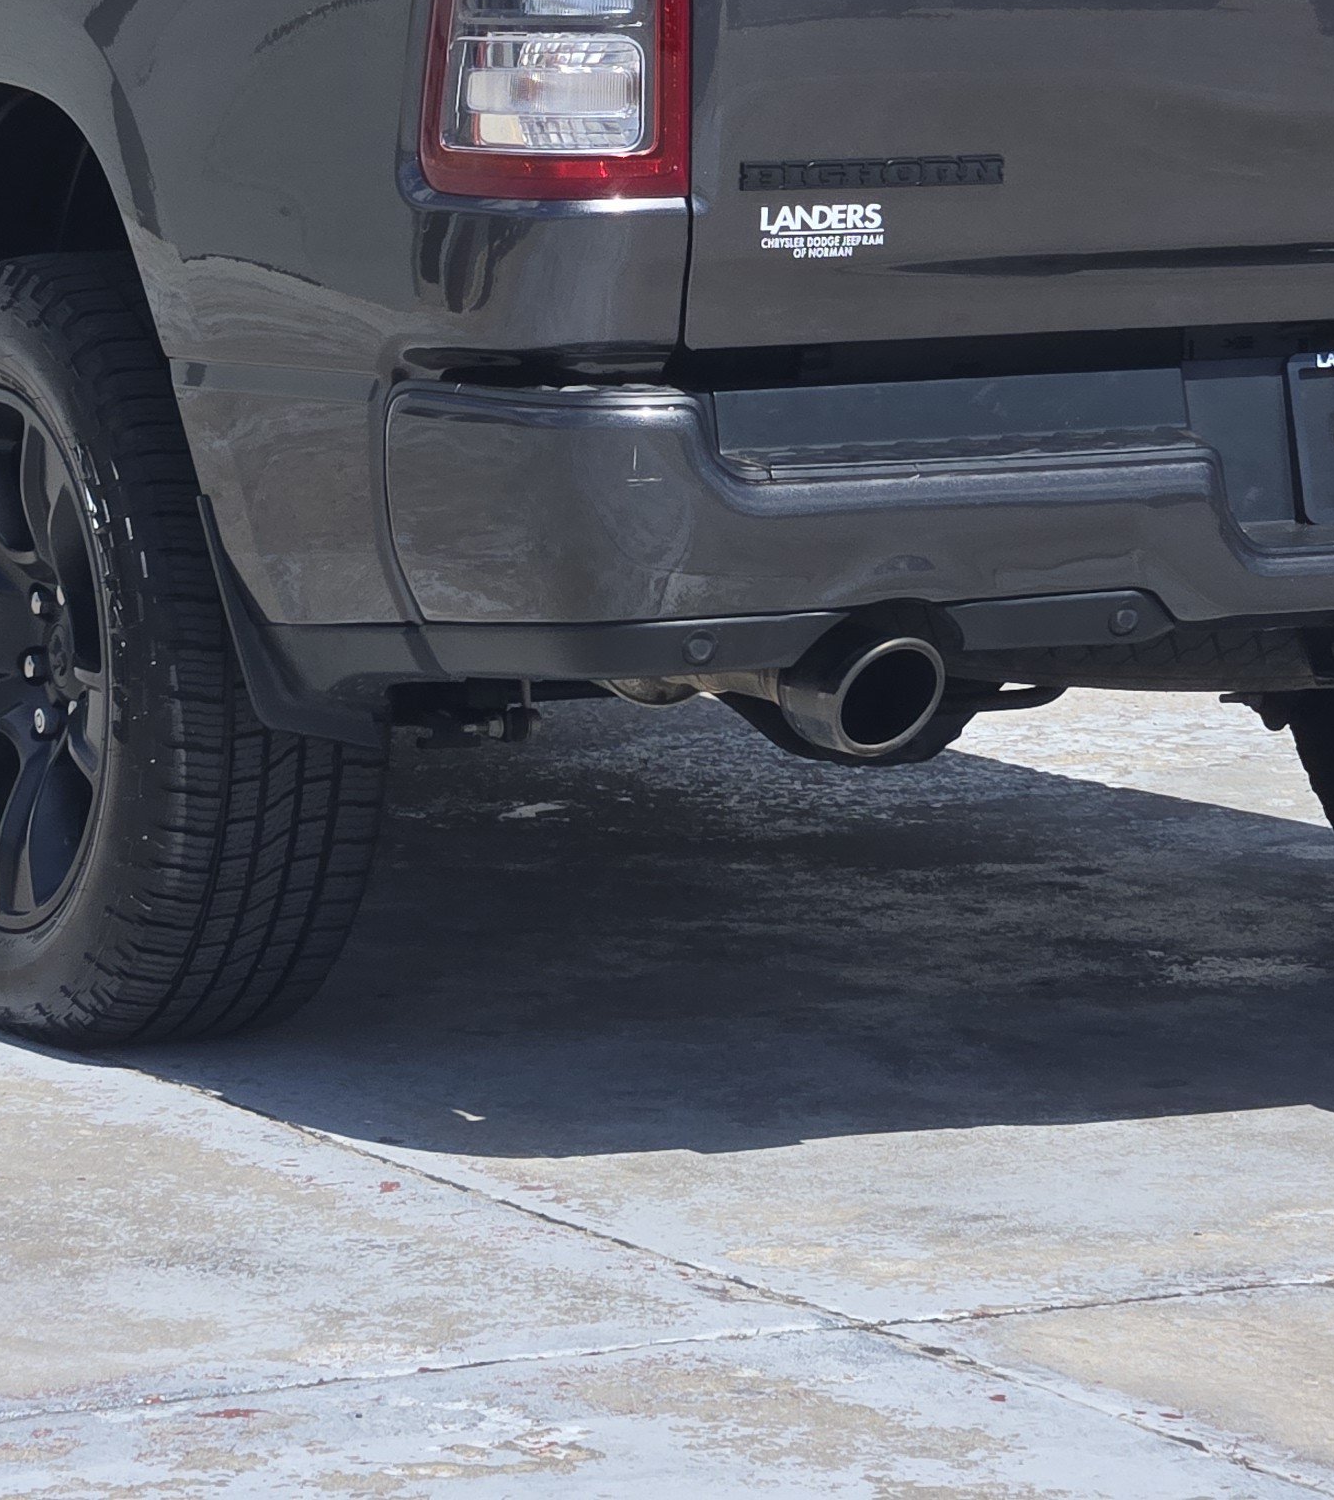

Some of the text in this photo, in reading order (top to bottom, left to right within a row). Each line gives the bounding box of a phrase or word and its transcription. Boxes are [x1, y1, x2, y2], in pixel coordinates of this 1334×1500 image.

[760, 203, 882, 235] LANDERS
[761, 234, 884, 249] CHRYSLER DODGE JEEP RAM
[792, 246, 853, 259] OF NORMAN
